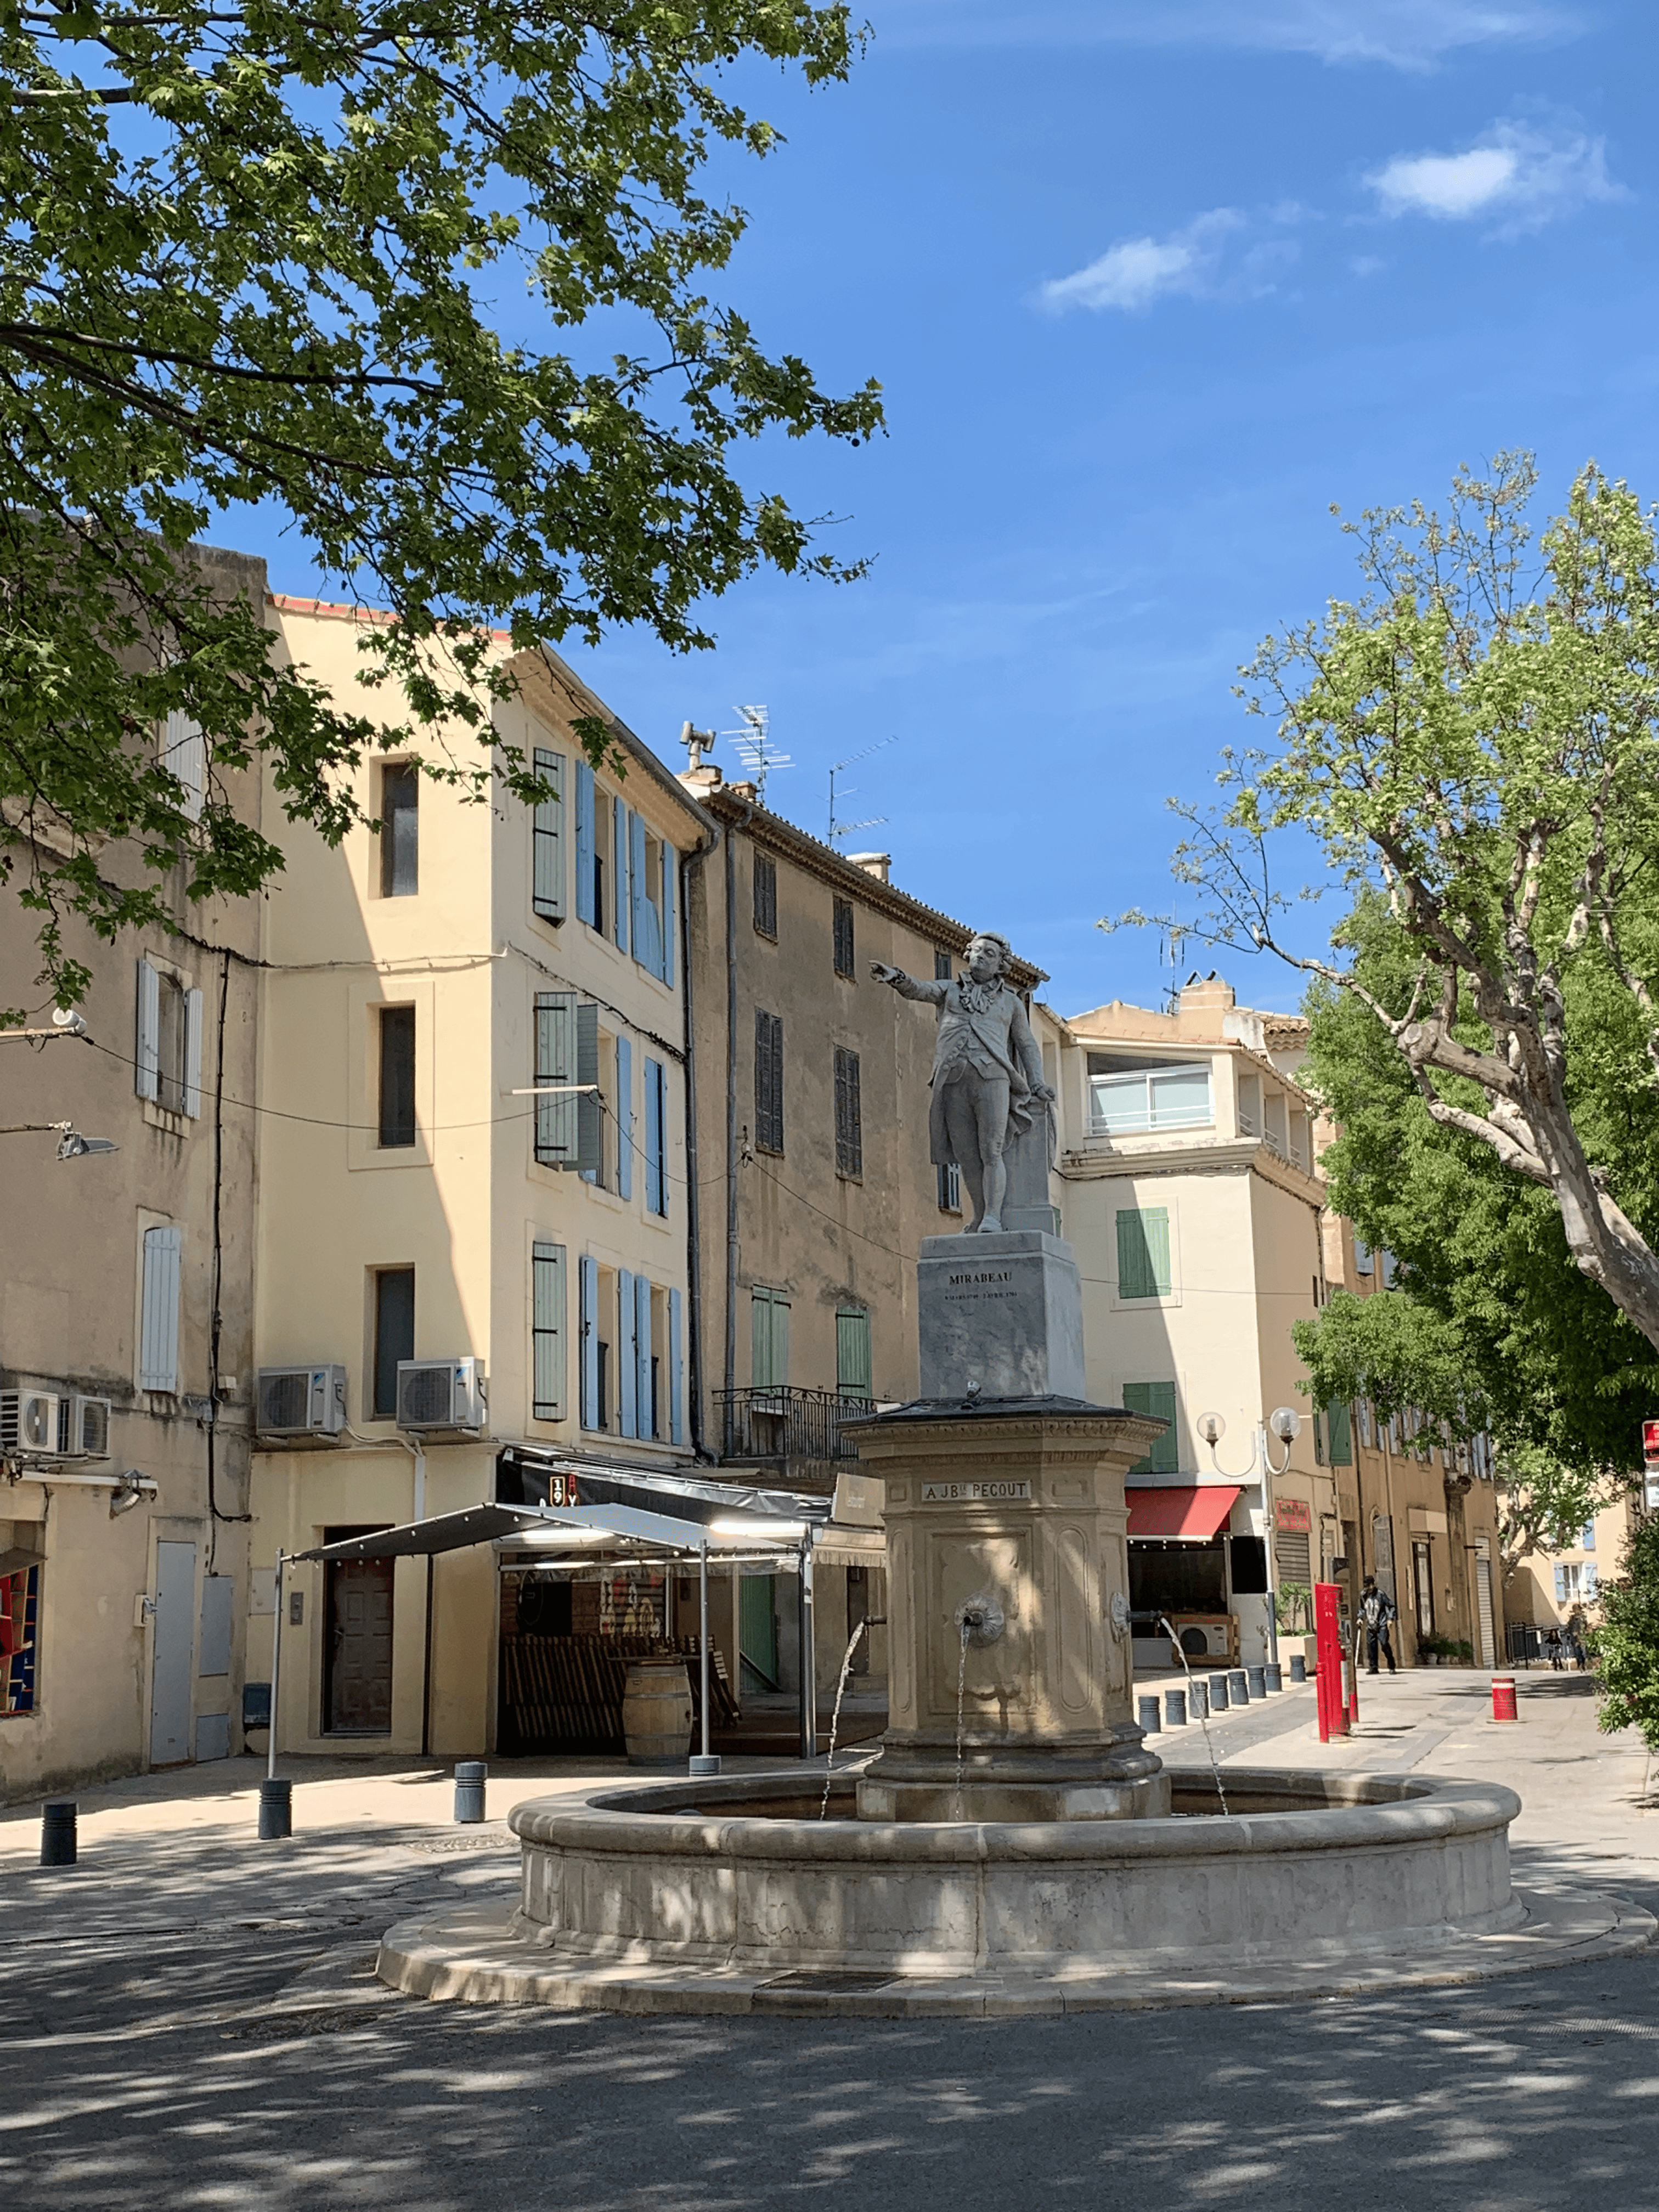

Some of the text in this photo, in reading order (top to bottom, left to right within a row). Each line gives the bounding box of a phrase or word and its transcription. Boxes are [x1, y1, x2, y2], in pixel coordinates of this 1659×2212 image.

[949, 1272, 1012, 1285] MIRABEAU
[554, 1479, 562, 1503] 19
[927, 1487, 936, 1499] A
[973, 1483, 1026, 1497] PECOUT
